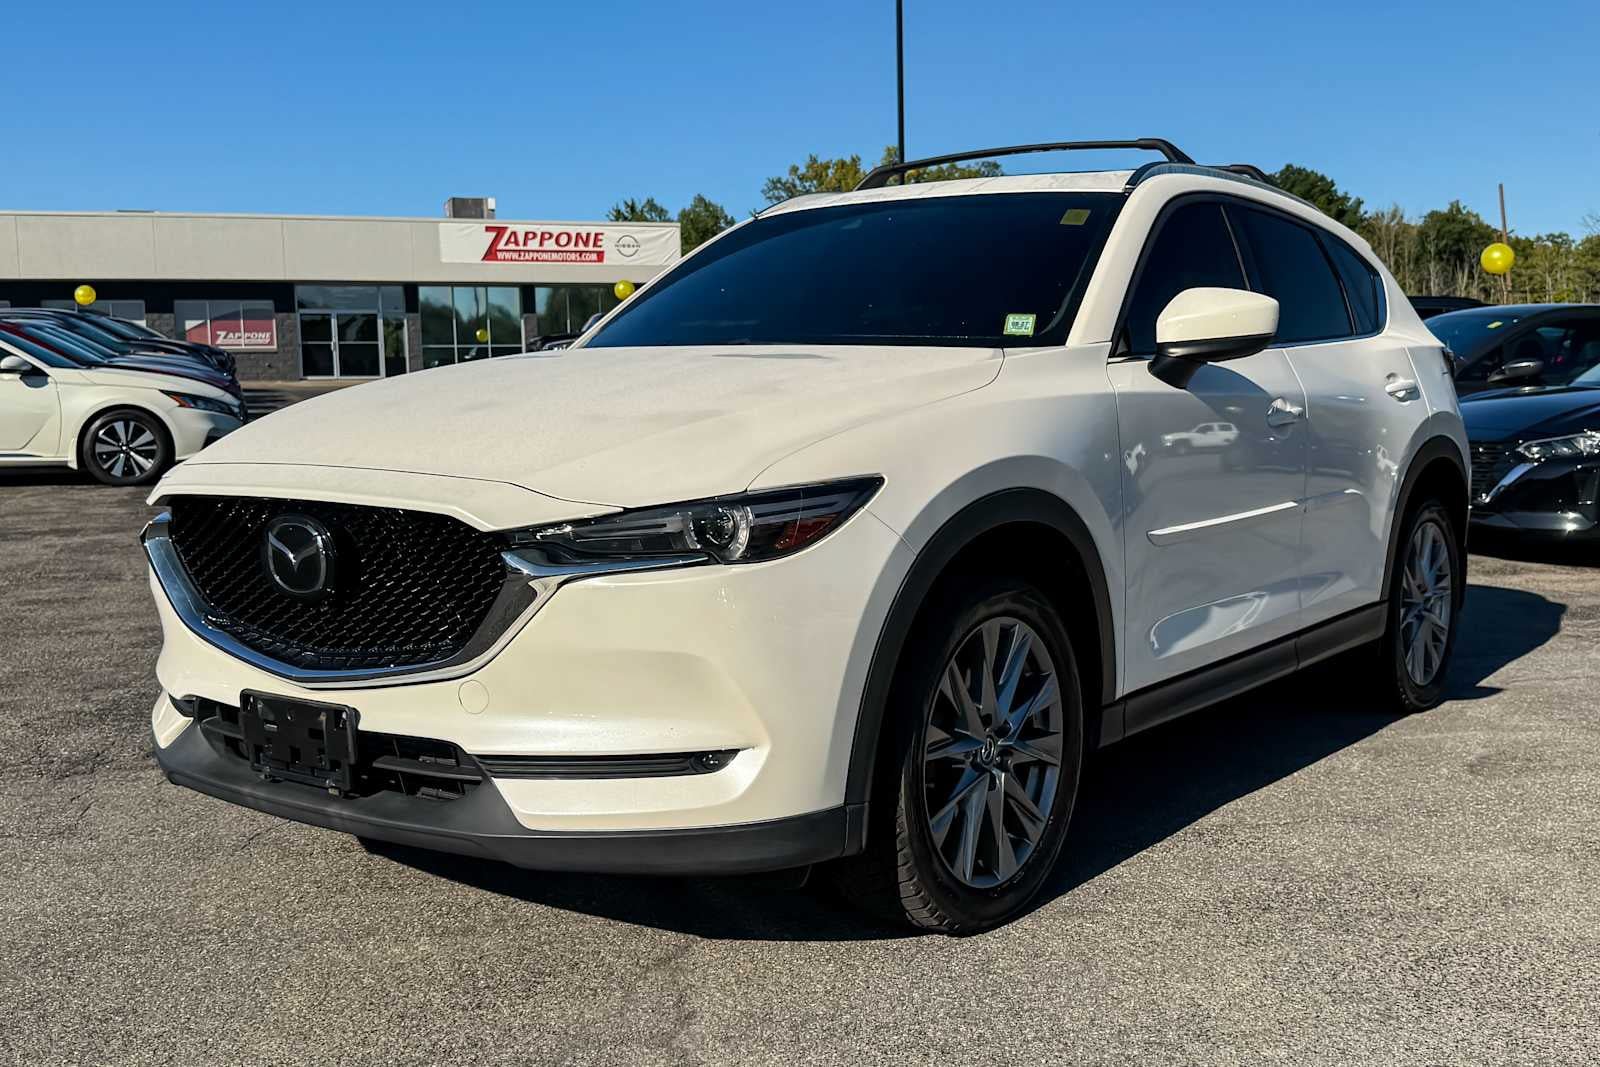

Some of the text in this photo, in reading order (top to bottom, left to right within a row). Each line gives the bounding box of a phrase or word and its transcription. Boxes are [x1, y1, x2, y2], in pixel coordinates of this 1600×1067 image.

[482, 226, 604, 261] ZAPPONE
[496, 251, 598, 262] WWW.ZAPPONEMOTORS.COM
[216, 331, 271, 344] ZAPPONE
